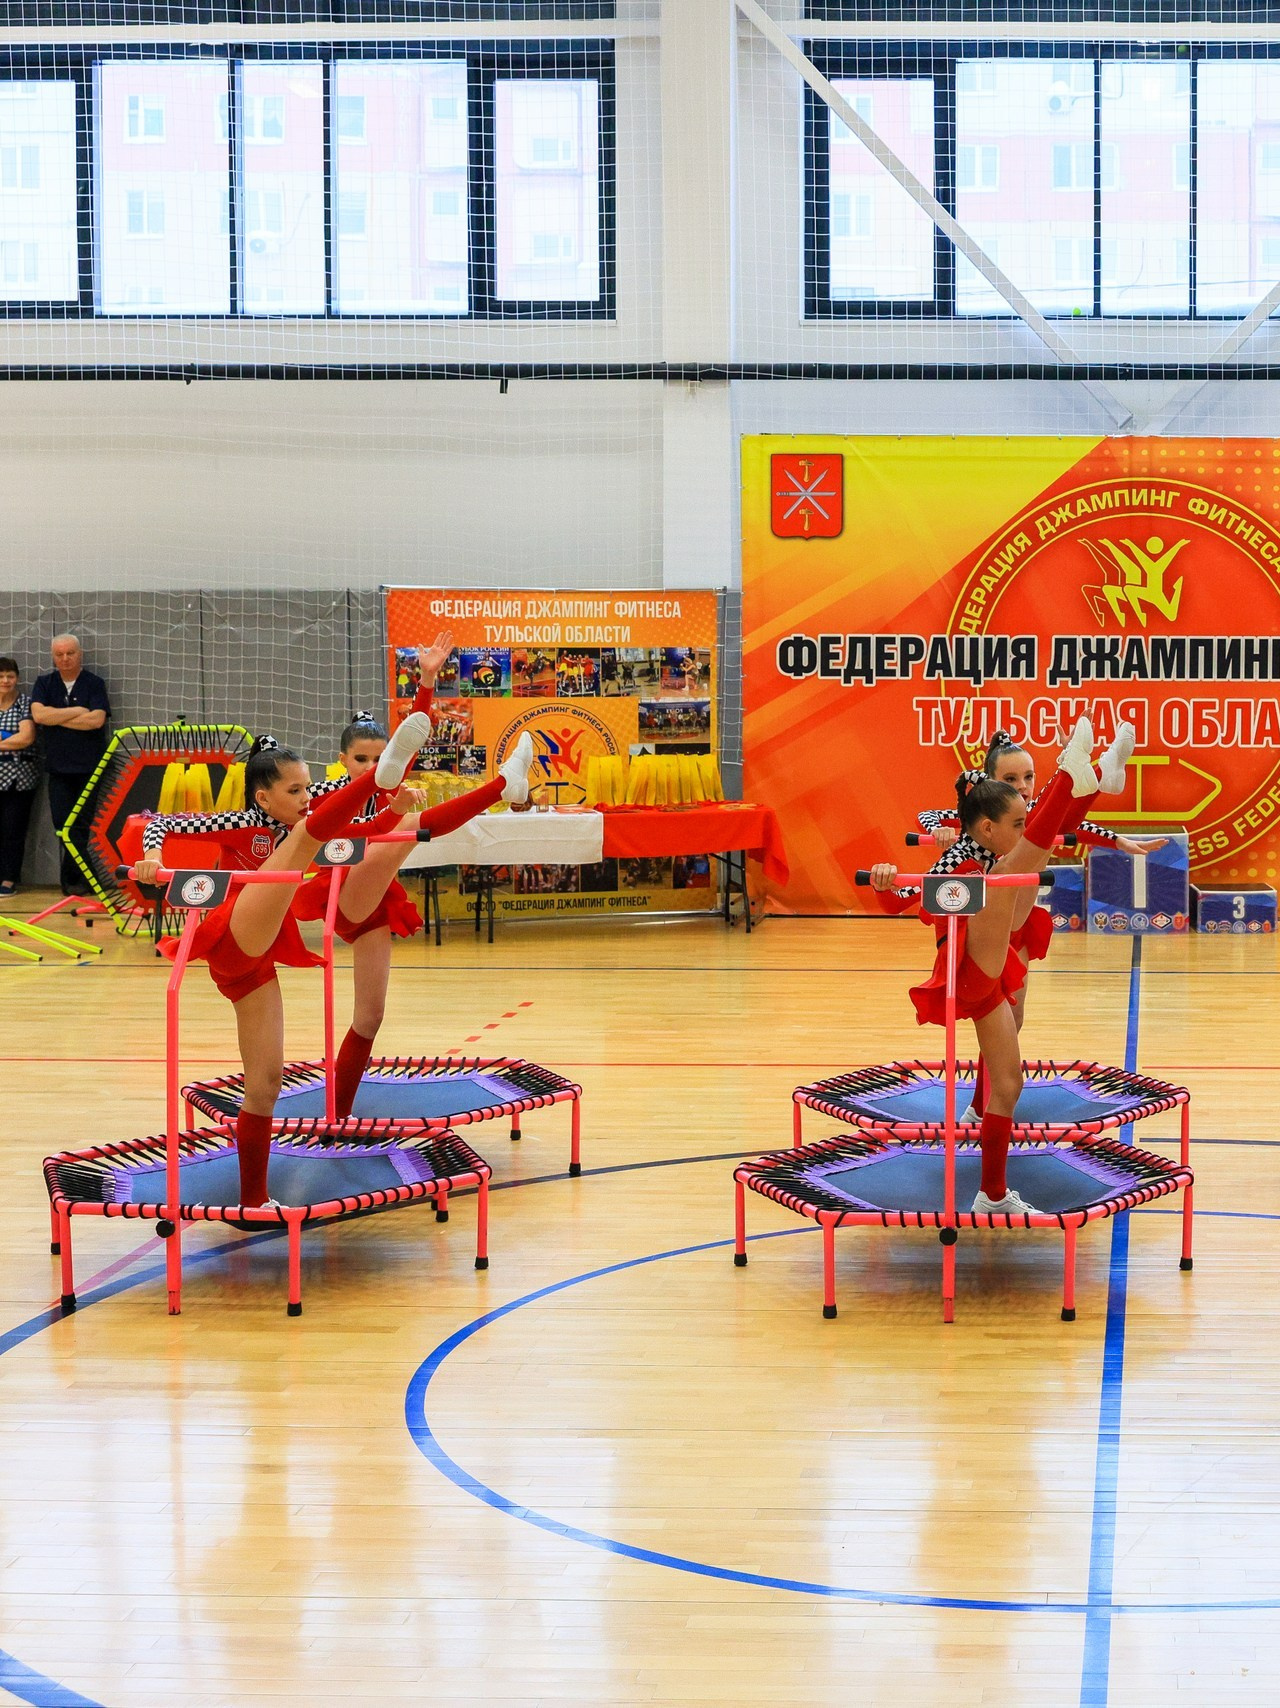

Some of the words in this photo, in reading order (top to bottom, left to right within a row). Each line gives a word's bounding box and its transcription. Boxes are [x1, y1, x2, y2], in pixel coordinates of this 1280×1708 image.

[958, 531, 1033, 636] ДЕРАЦИЯ
[1034, 488, 1181, 541] ДЖАМПИНГ
[430, 600, 522, 619] ФЕДЕРАЦИЯ
[525, 600, 611, 620] ДЖАМПИНГ
[614, 600, 682, 619] ФИТНЕСА
[484, 622, 561, 644] ТУЛЬСКОЙ
[565, 625, 631, 644] ОБЛАСТИ
[777, 633, 1039, 686] ФЕДЕРАЦИЯ
[913, 697, 1149, 748] ТУЛЬСКАЯ
[496, 719, 522, 764] ФЕДЕРАЦИЯ
[523, 706, 570, 722] ДЖАМПИНГ
[571, 708, 604, 734] ФИТНЕСА
[419, 746, 440, 754] УБОК
[499, 899, 555, 911] "ФЕДЕРАЦИЯ
[556, 897, 606, 910] ДЖАМПИНГ
[608, 896, 652, 906] ФИТНЕСА"
[1232, 896, 1245, 919] 3
